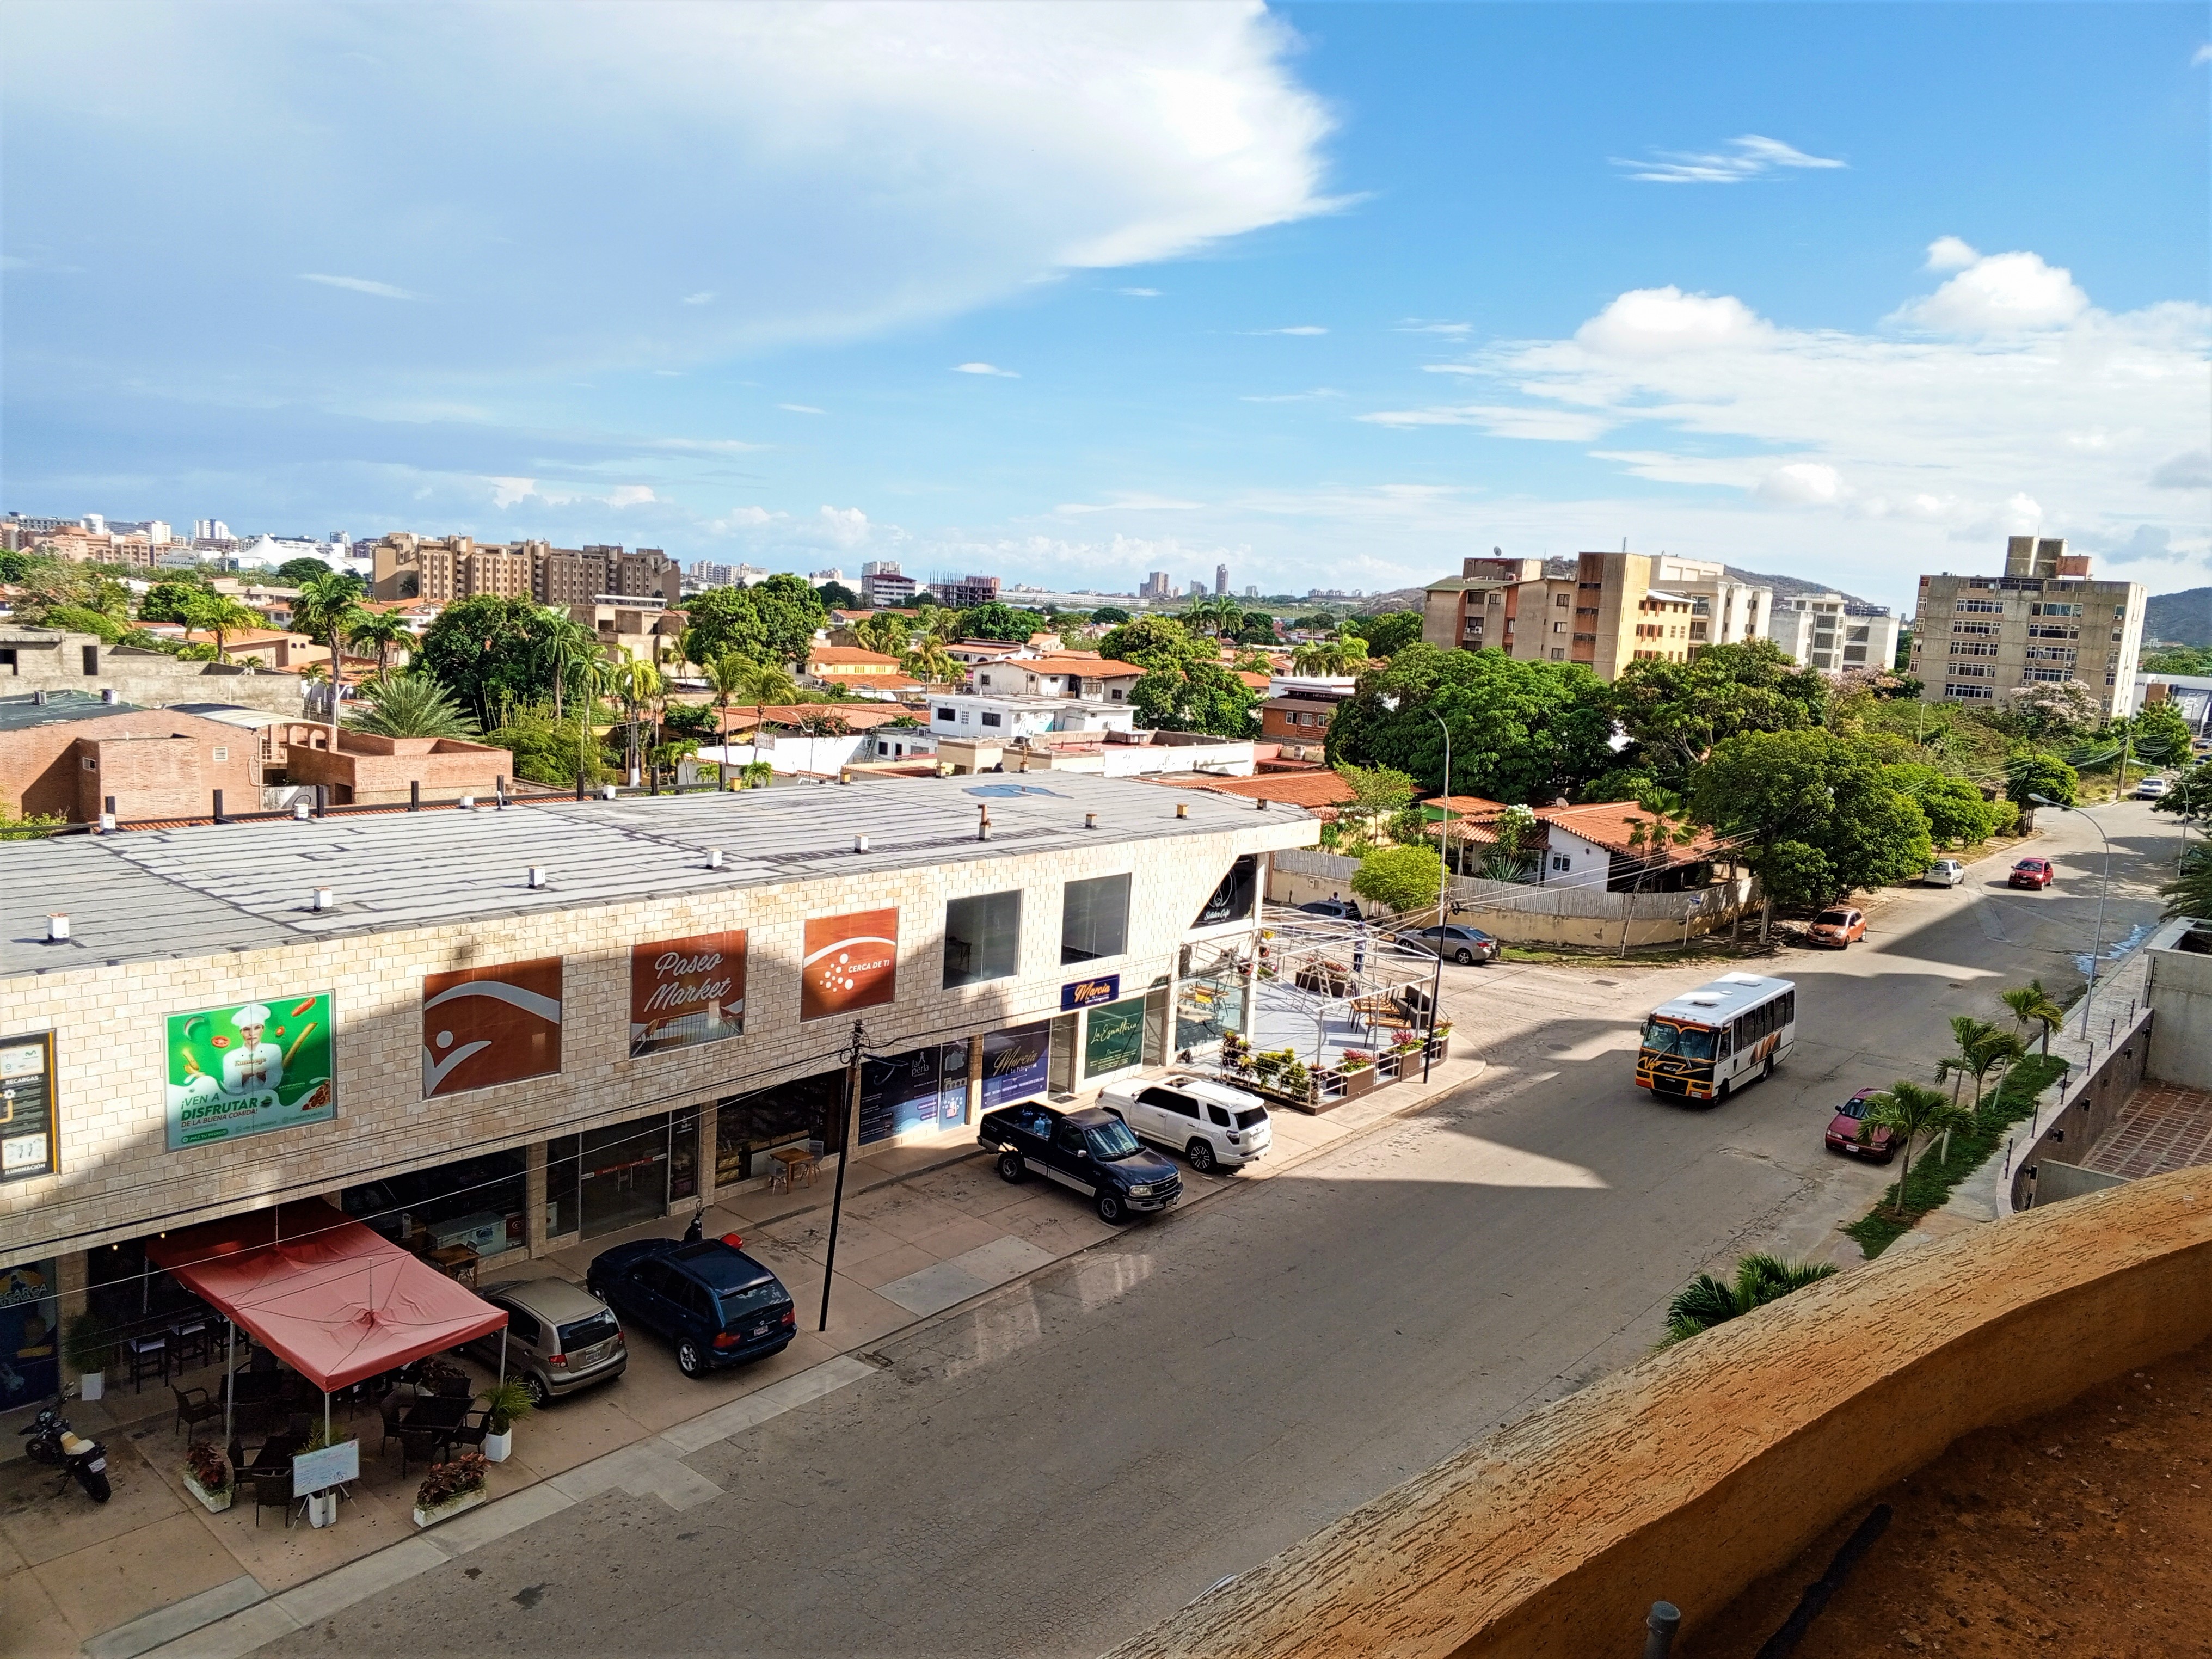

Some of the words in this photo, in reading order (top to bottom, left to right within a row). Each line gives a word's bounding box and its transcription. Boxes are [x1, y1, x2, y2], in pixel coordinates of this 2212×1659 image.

[655, 952, 724, 979] Paseo
[848, 963, 871, 973] CERCA
[872, 960, 882, 969] DE
[644, 977, 732, 1012] Market
[1074, 981, 1110, 1003] Marcia
[1090, 1027, 1101, 1044] La
[993, 1046, 1038, 1077] Marcia
[912, 1064, 929, 1077] perla
[5, 1076, 39, 1085] RECARGAS
[181, 1095, 208, 1109] ¡VEN
[212, 1093, 220, 1102] A
[181, 1098, 258, 1121] DISFRUTAR
[203, 1114, 227, 1123] BUENA
[229, 1108, 258, 1118] COMIDA!
[5, 1163, 46, 1175] ILUMINACIÓN
